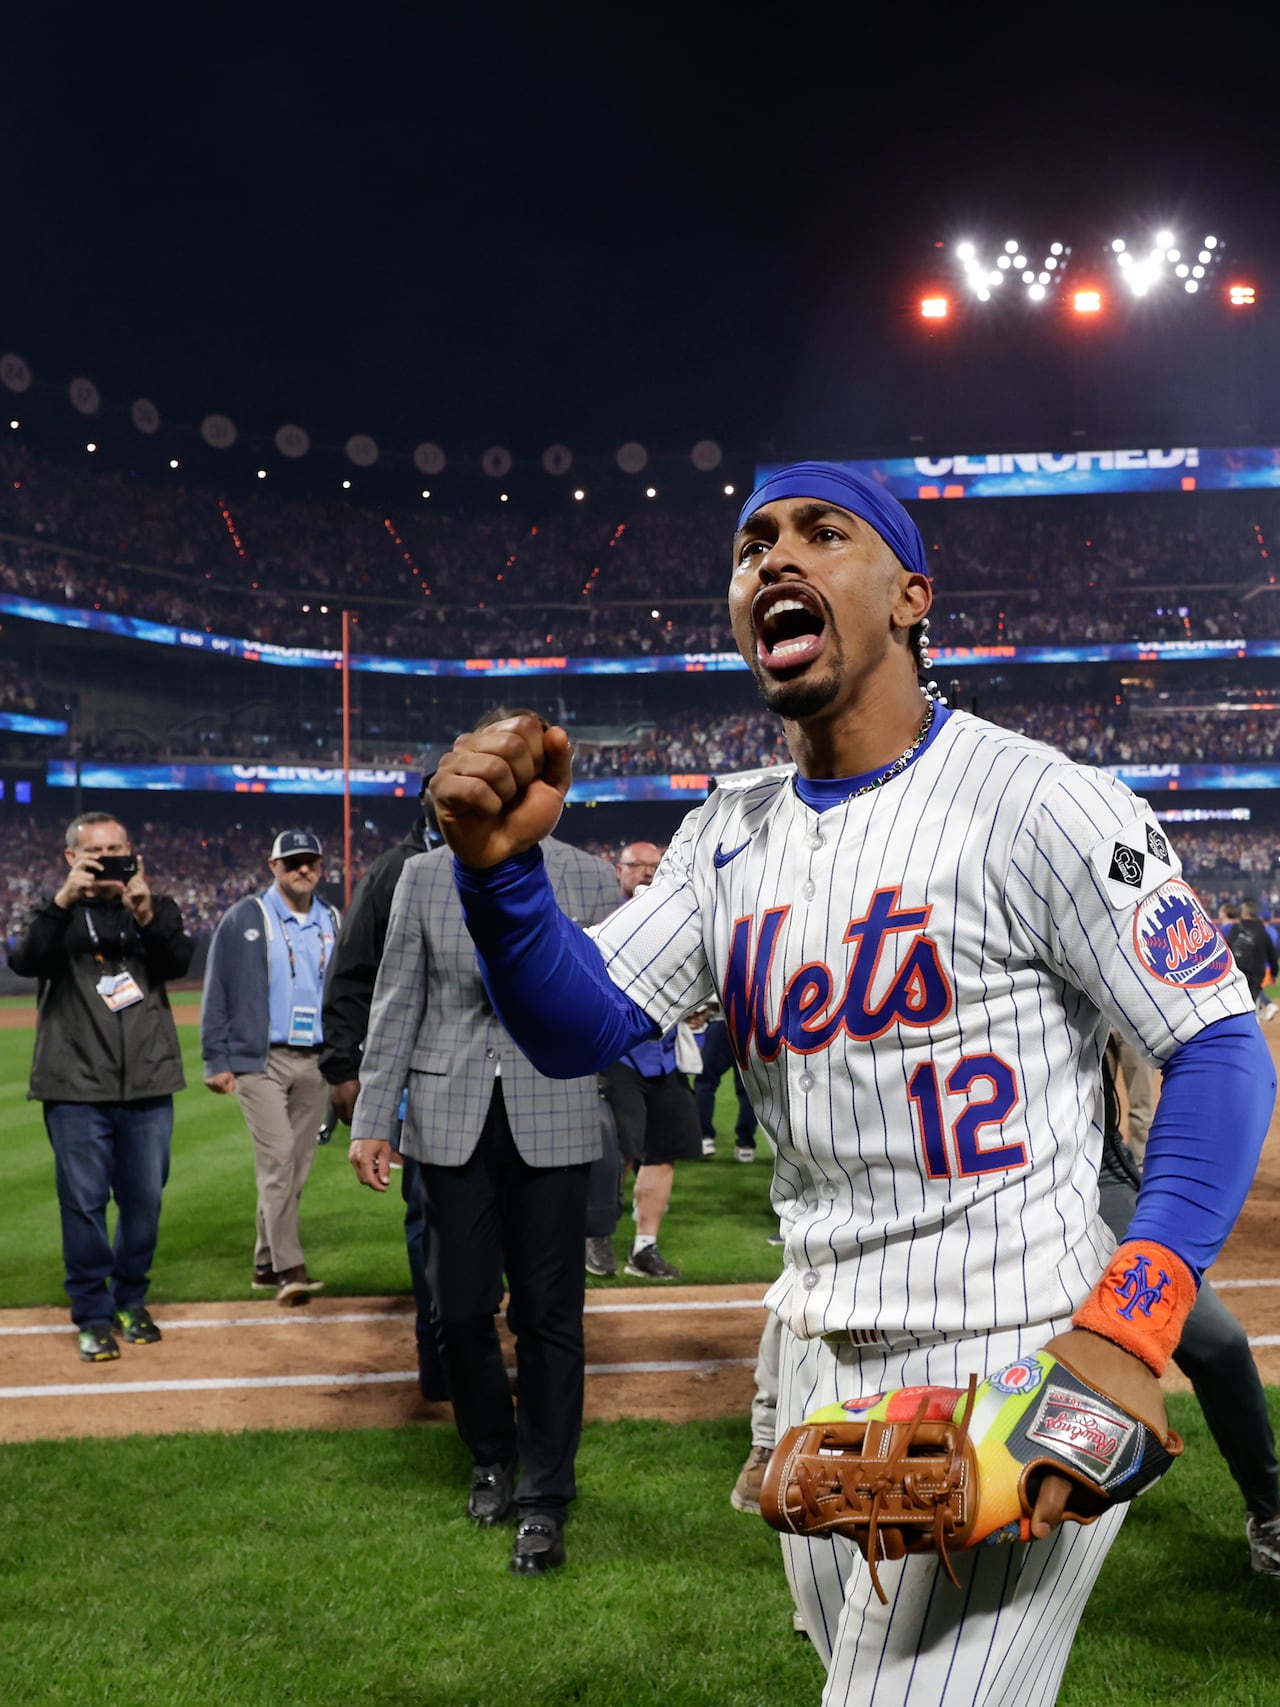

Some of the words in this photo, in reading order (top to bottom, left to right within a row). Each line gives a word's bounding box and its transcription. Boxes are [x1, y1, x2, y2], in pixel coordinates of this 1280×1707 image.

[1165, 910, 1215, 970] Mets
[723, 885, 953, 1069] Mets
[907, 1053, 1027, 1178] 12
[1114, 1254, 1171, 1321] NY
[1045, 1411, 1117, 1456] Rawlings
